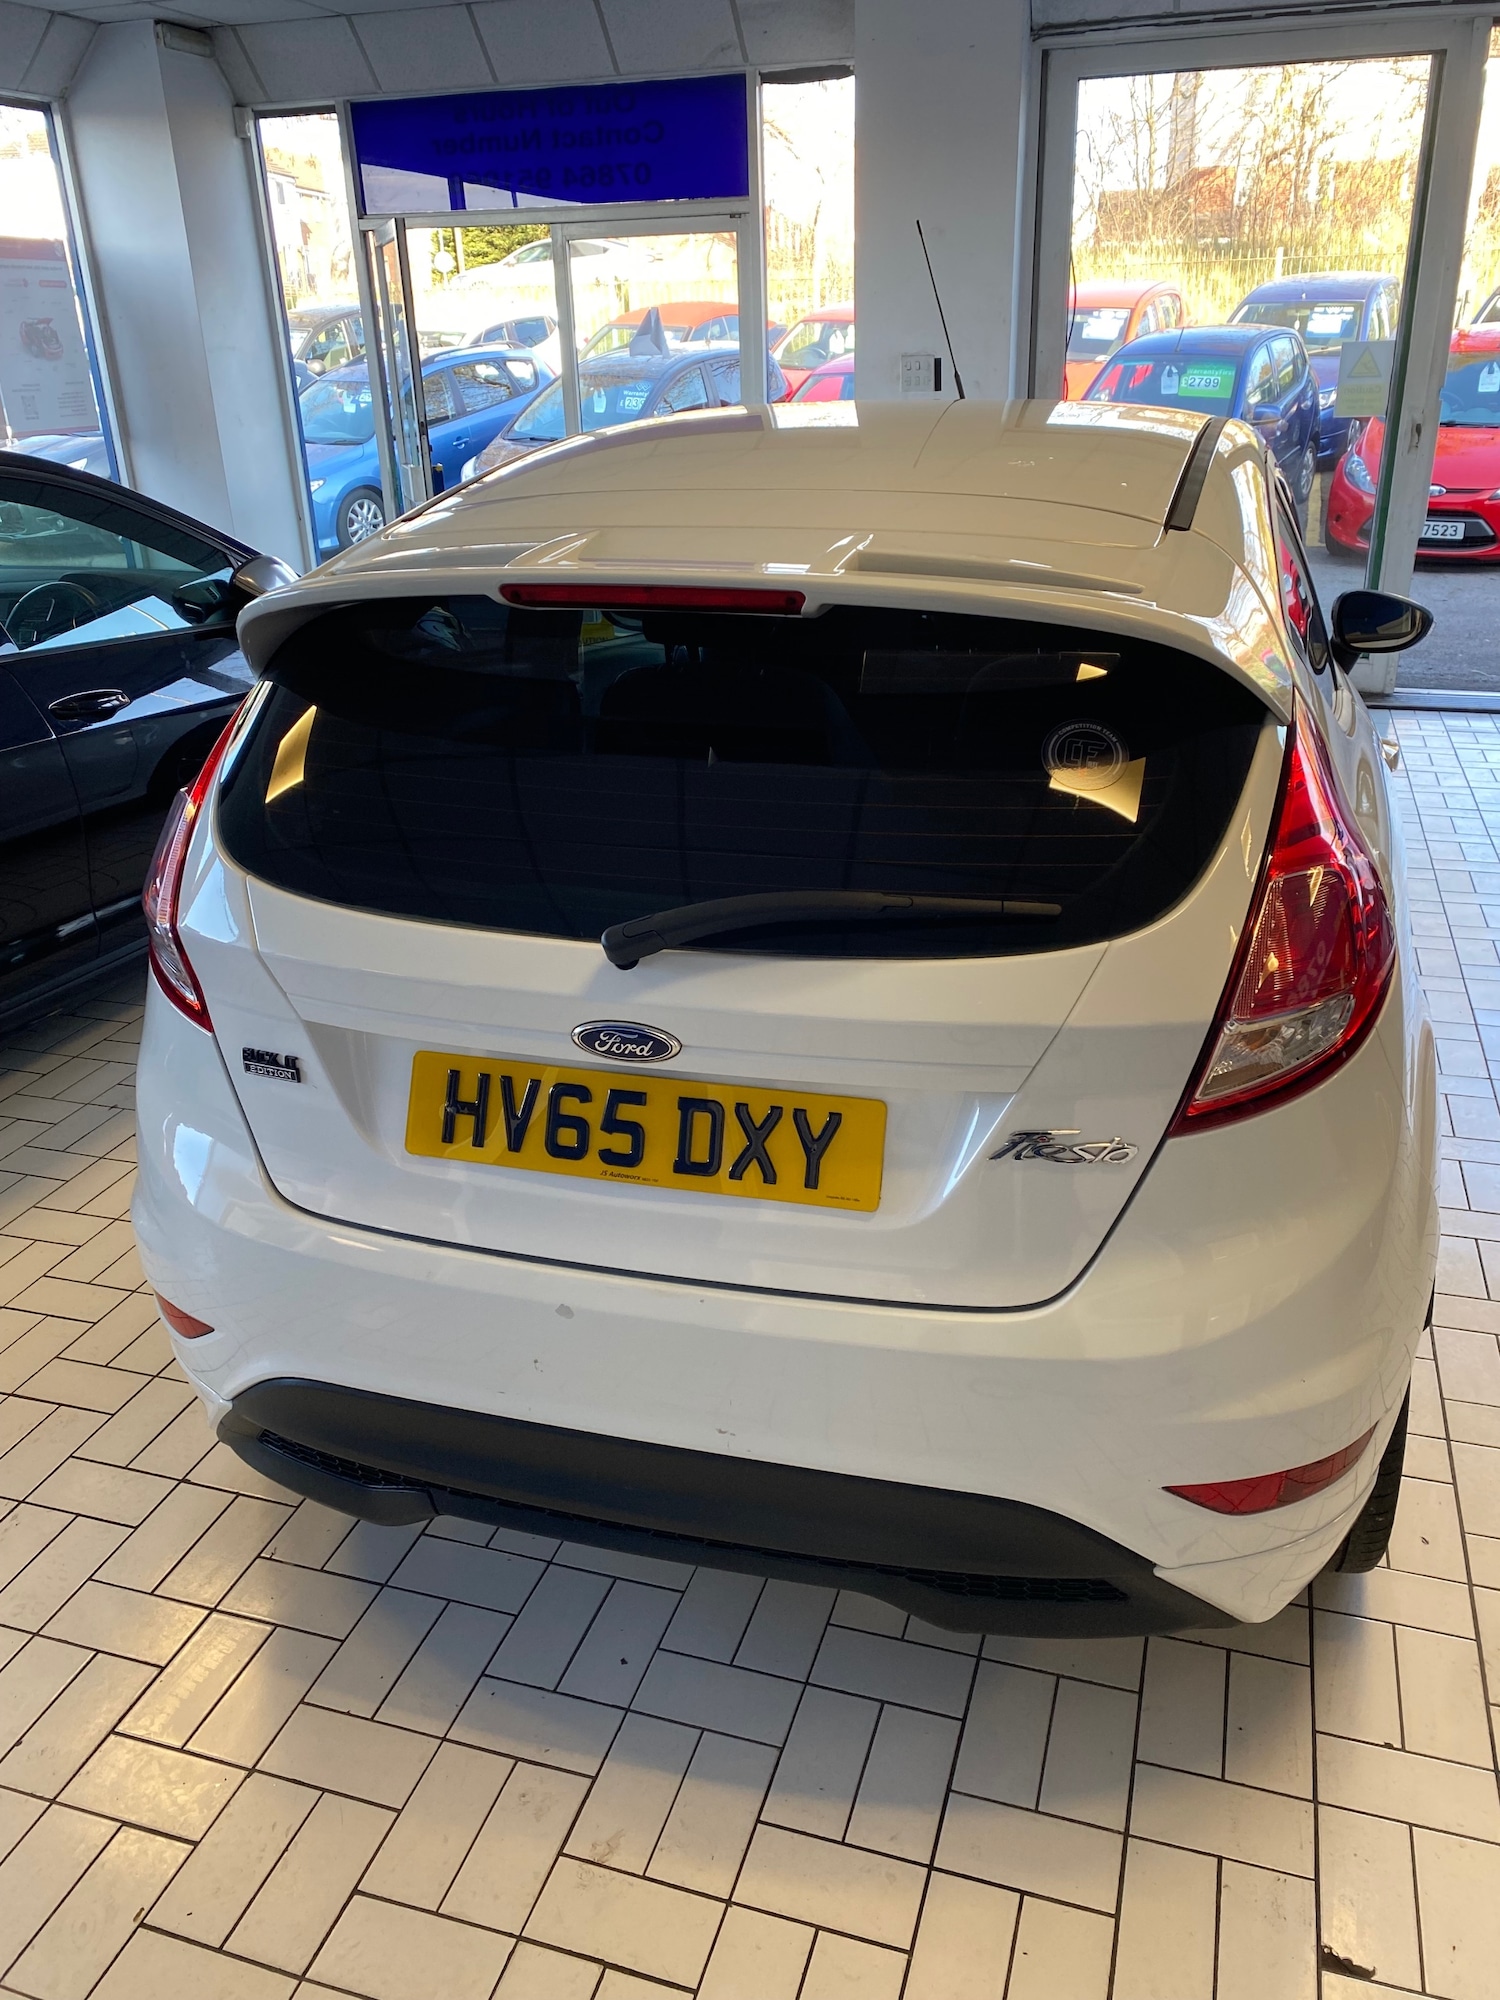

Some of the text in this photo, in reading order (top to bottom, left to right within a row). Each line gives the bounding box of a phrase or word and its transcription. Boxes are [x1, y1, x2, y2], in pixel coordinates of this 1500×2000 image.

[1058, 723, 1118, 742] COMPETITION TEAM
[594, 1031, 655, 1058] Ford
[250, 1065, 292, 1079] EDITION
[441, 1068, 842, 1190] HV65 DXY
[986, 1129, 1139, 1163] Fiesta
[609, 1171, 641, 1180] Autoworx
